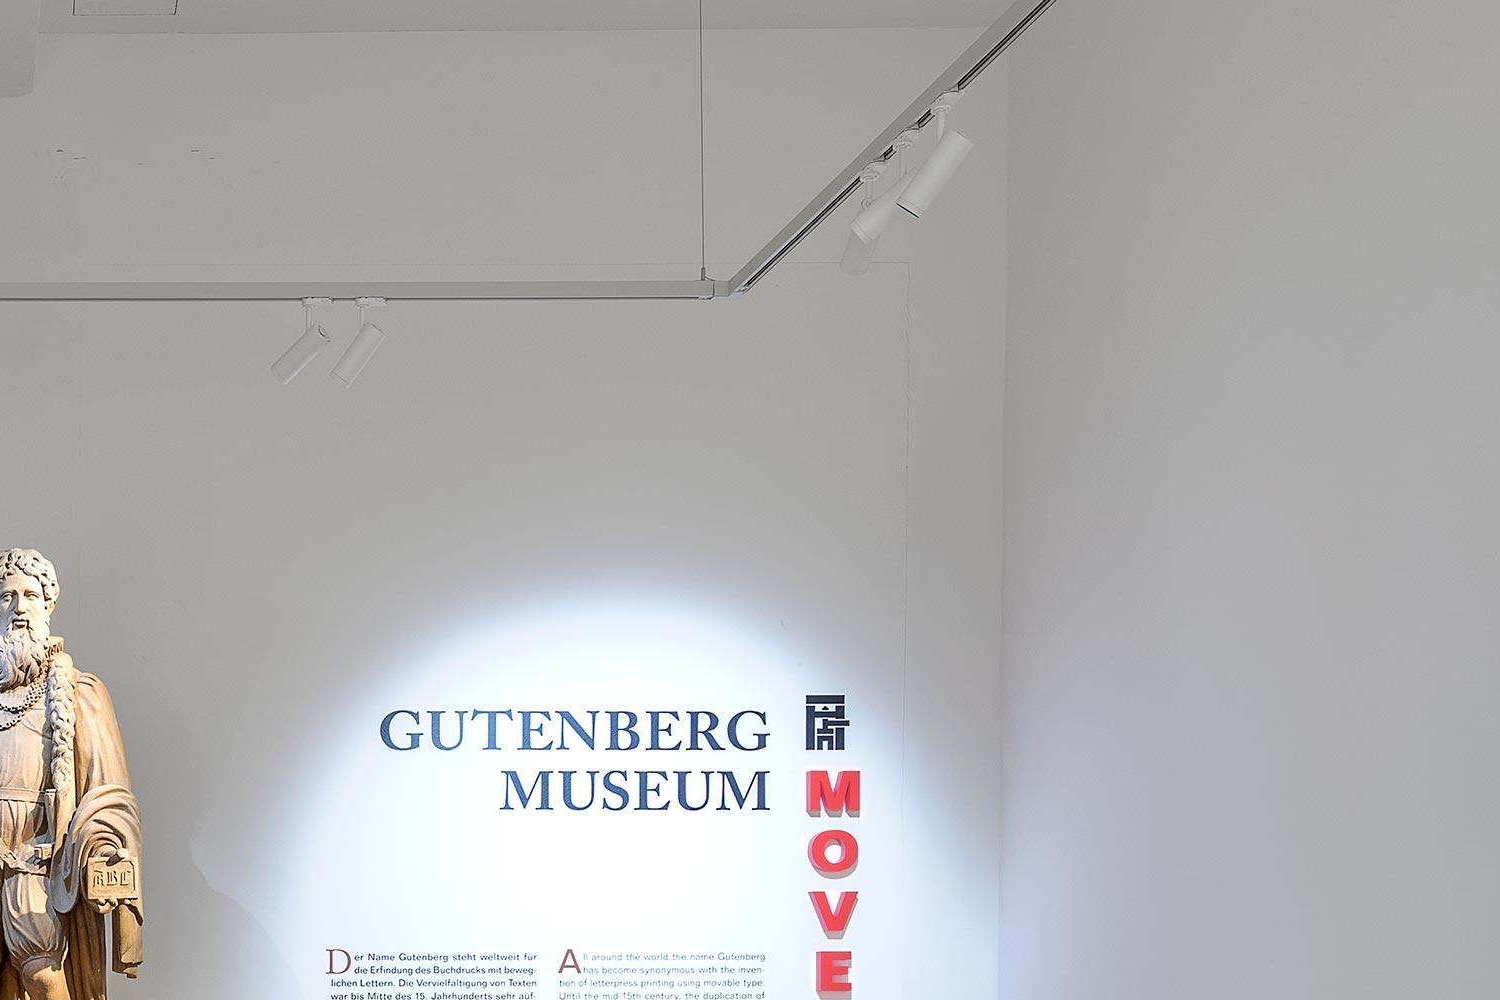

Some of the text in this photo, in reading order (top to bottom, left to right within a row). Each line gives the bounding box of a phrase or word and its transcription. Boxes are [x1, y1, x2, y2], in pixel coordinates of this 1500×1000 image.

[379, 708, 771, 752] GUTENBERG
[499, 770, 771, 812] MUSEUM
[353, 965, 537, 976] die Erfindung des Buchdrucks mit beweg-
